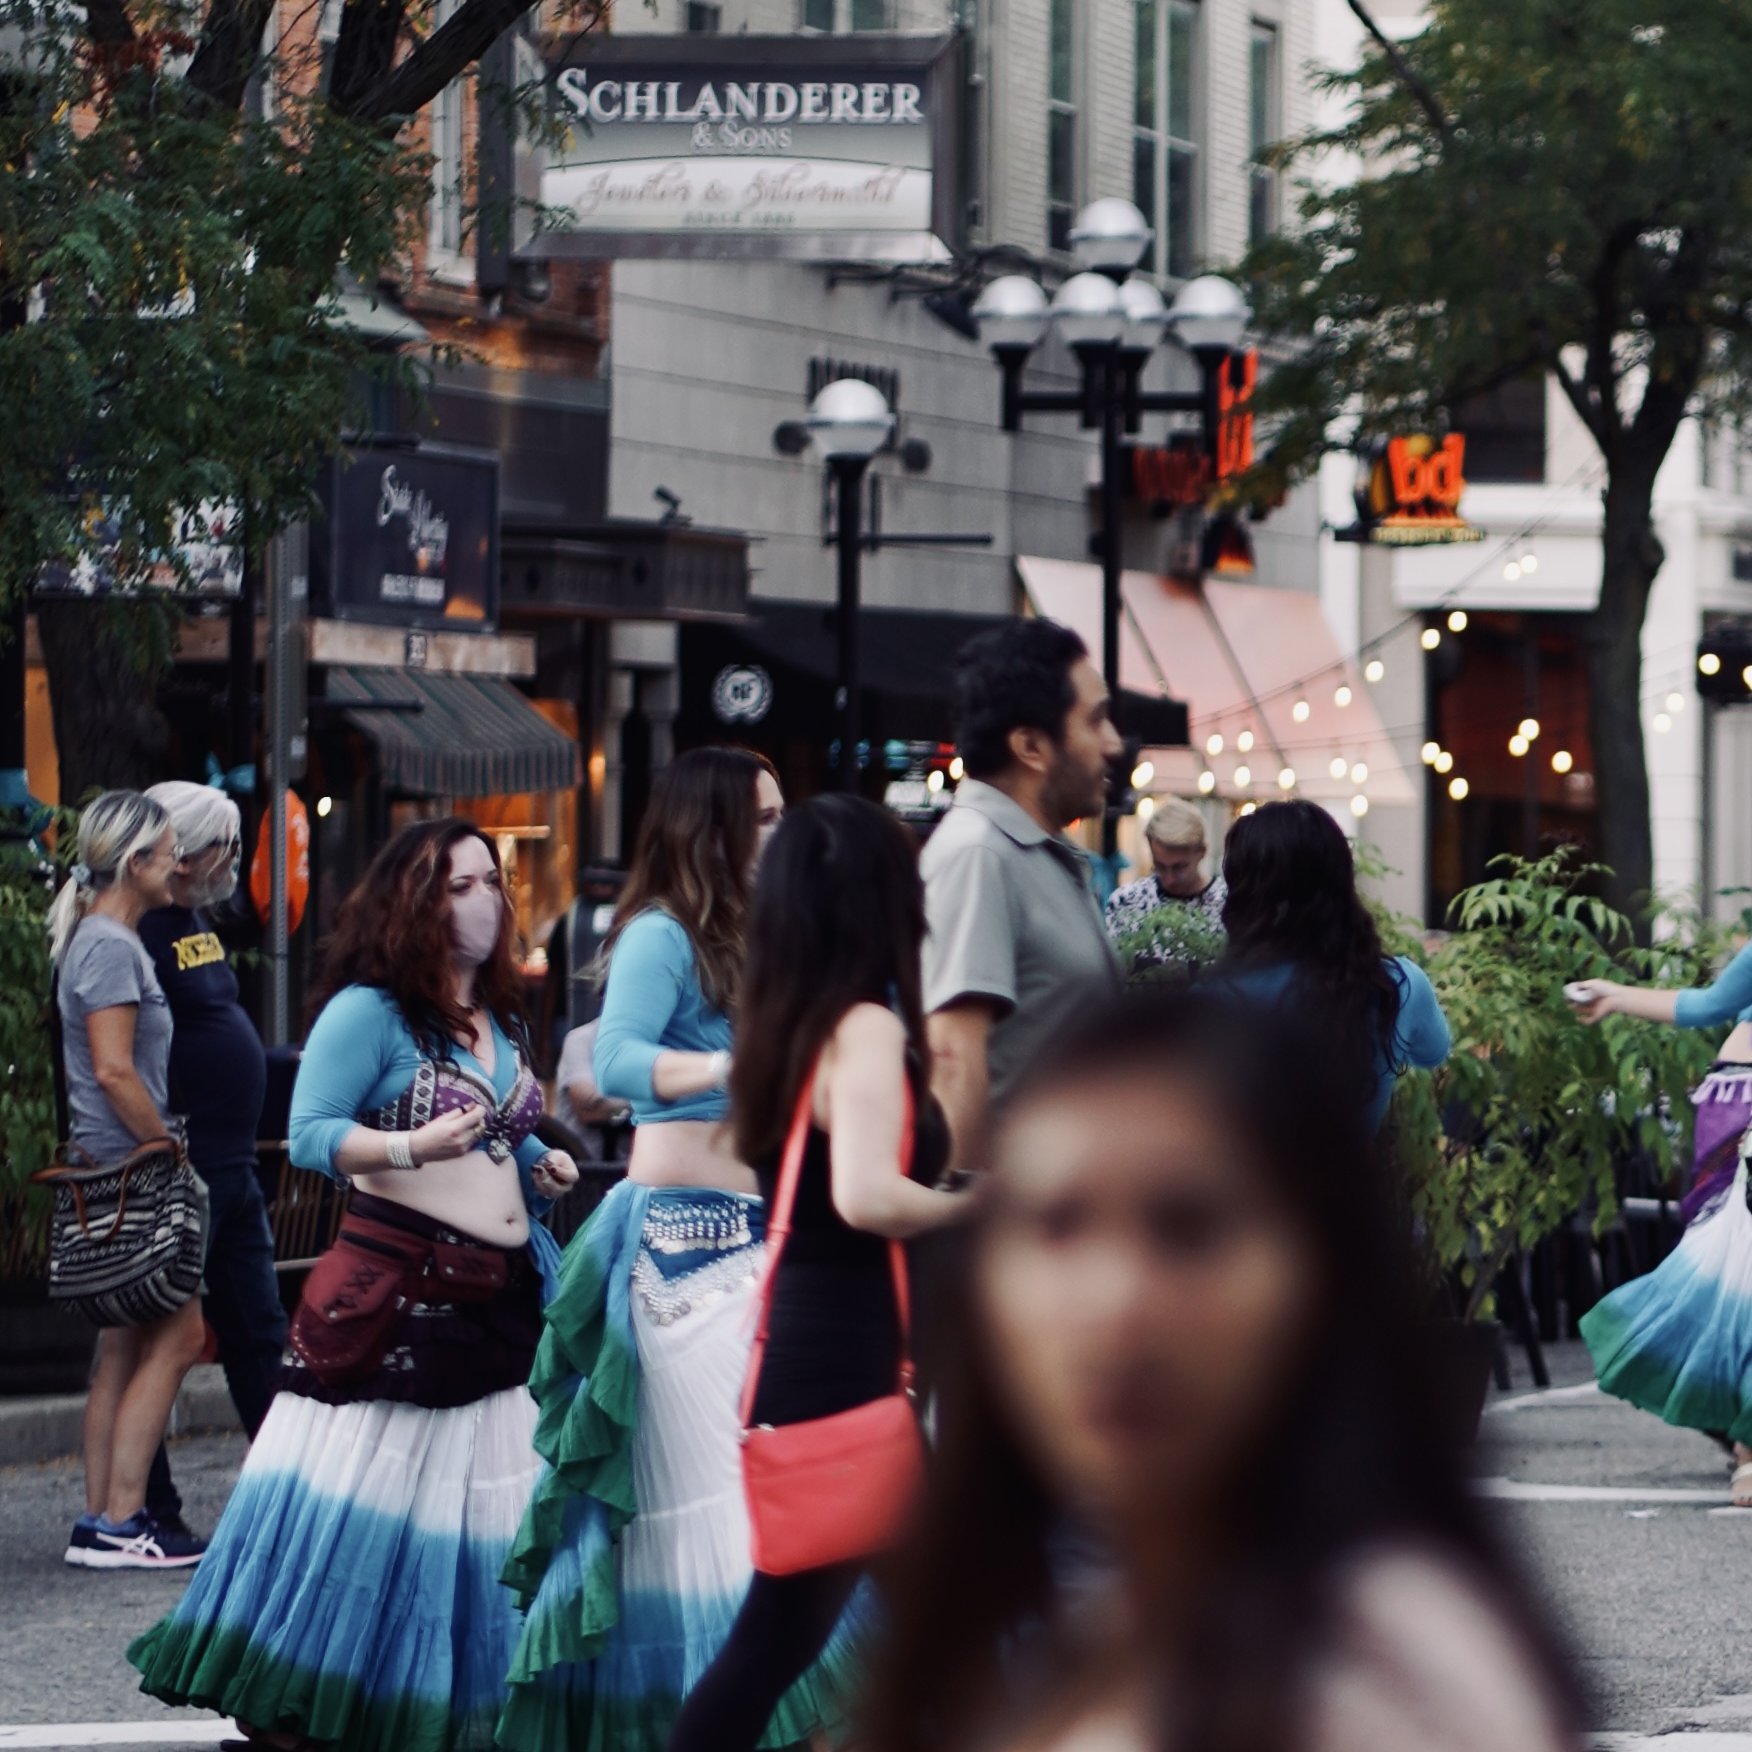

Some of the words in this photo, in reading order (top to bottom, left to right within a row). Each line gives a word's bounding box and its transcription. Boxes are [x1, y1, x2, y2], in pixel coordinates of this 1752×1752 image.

[556, 67, 924, 124] SCHLANDERER
[691, 121, 714, 148] &
[718, 117, 793, 148] SONS
